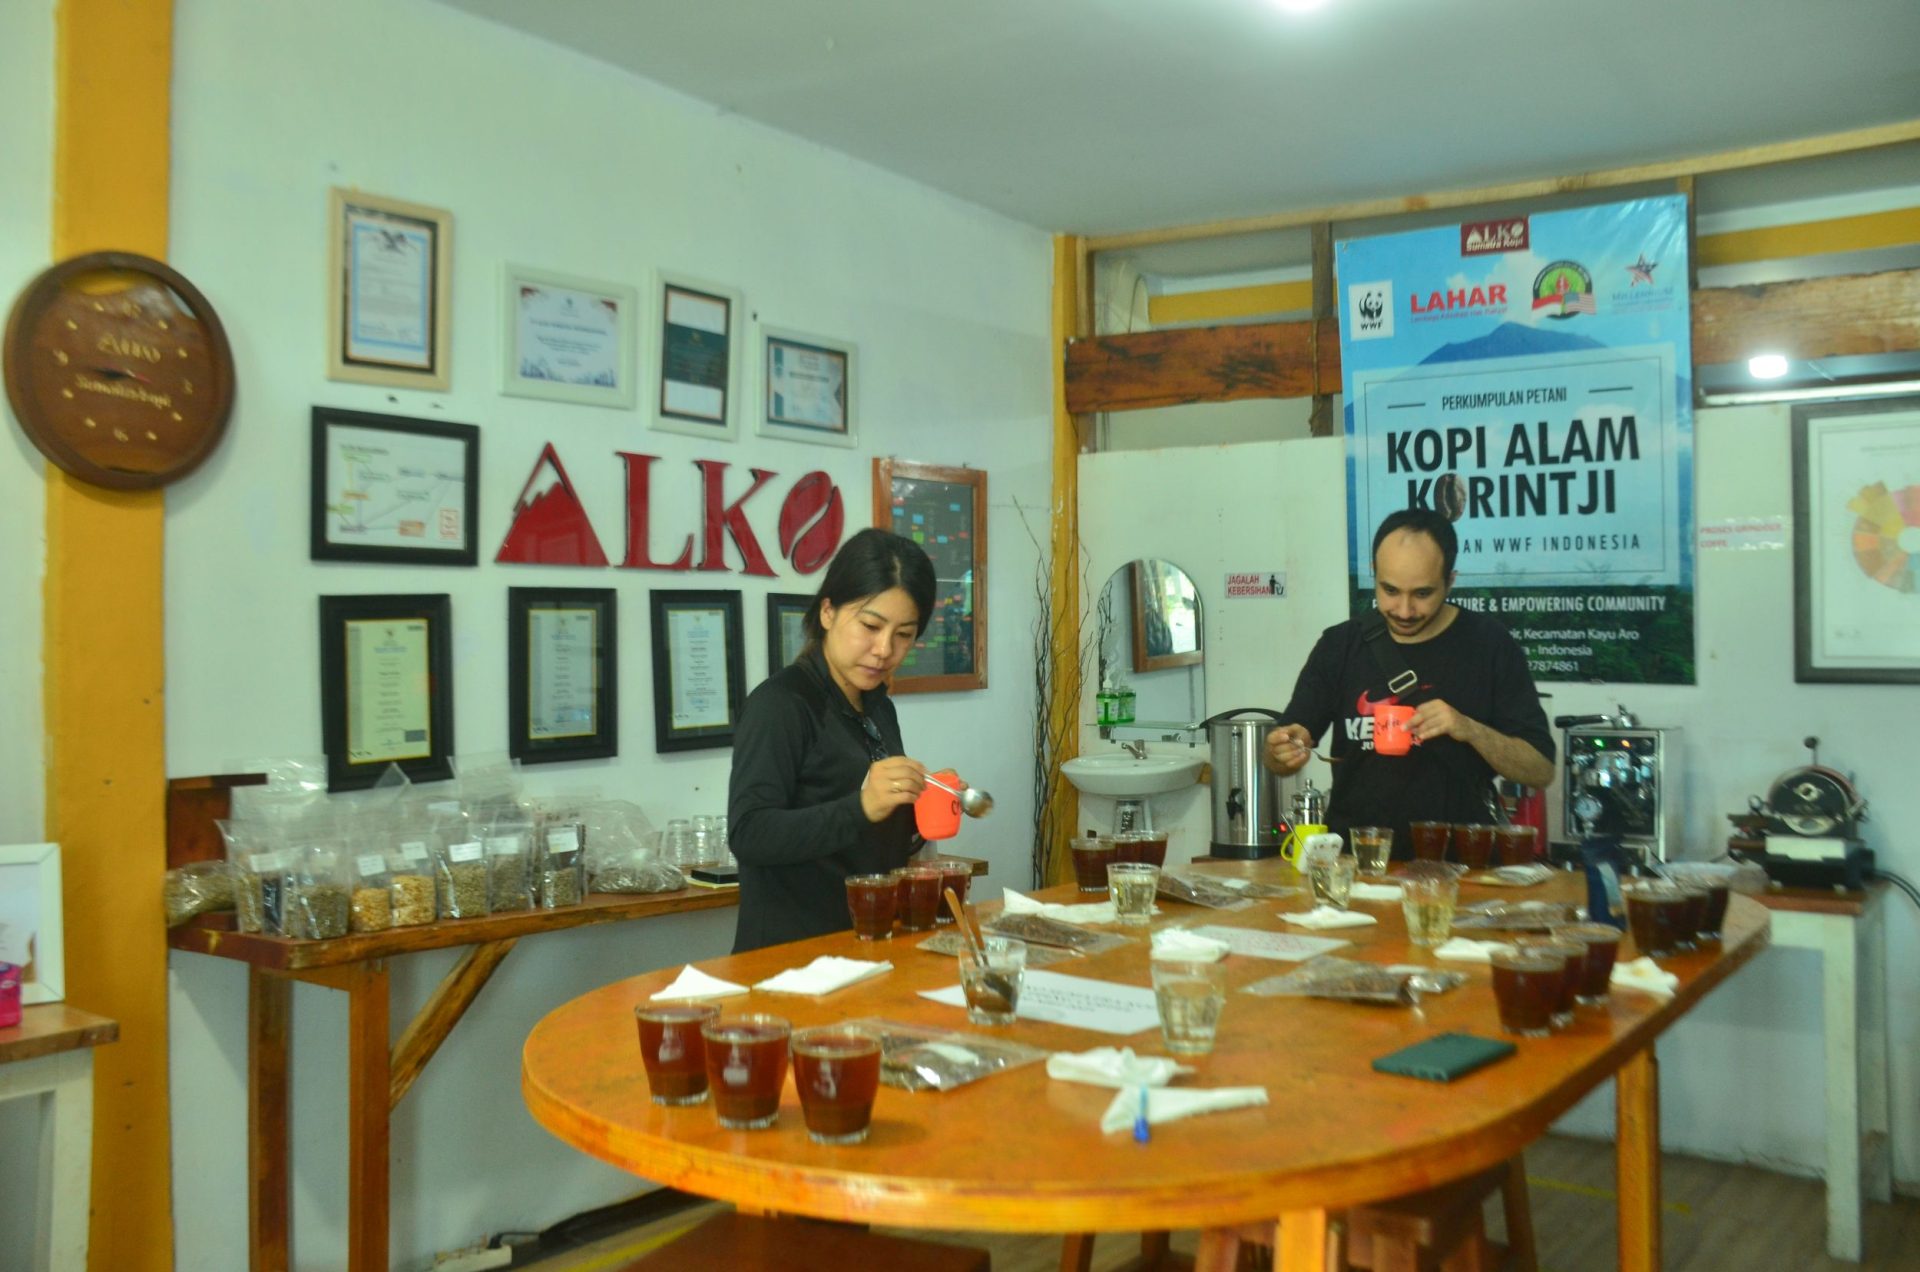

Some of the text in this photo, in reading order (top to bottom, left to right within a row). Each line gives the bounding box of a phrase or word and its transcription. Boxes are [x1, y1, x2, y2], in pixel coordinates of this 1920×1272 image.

[1410, 284, 1507, 314] LAHAR
[1360, 320, 1383, 330] WWF
[1442, 386, 1567, 411] PERKUMPULAN PETANI
[1387, 416, 1640, 473] KOPI ALAM
[495, 442, 845, 577] ALKO
[1493, 536, 1532, 552] WWF
[1543, 533, 1640, 551] INDONESIA
[1227, 575, 1259, 585] JAGALAH
[1227, 586, 1272, 596] KEBERSIHAN
[1489, 598, 1498, 612] &
[1501, 596, 1584, 612] EMPOWERING
[1587, 596, 1666, 612] COMMUNITY
[1523, 627, 1586, 640] Kecamatan
[1588, 628, 1616, 643] Kayu
[1618, 628, 1640, 640] Aro
[1538, 644, 1593, 656] Indonesia
[1345, 716, 1375, 741] KE
